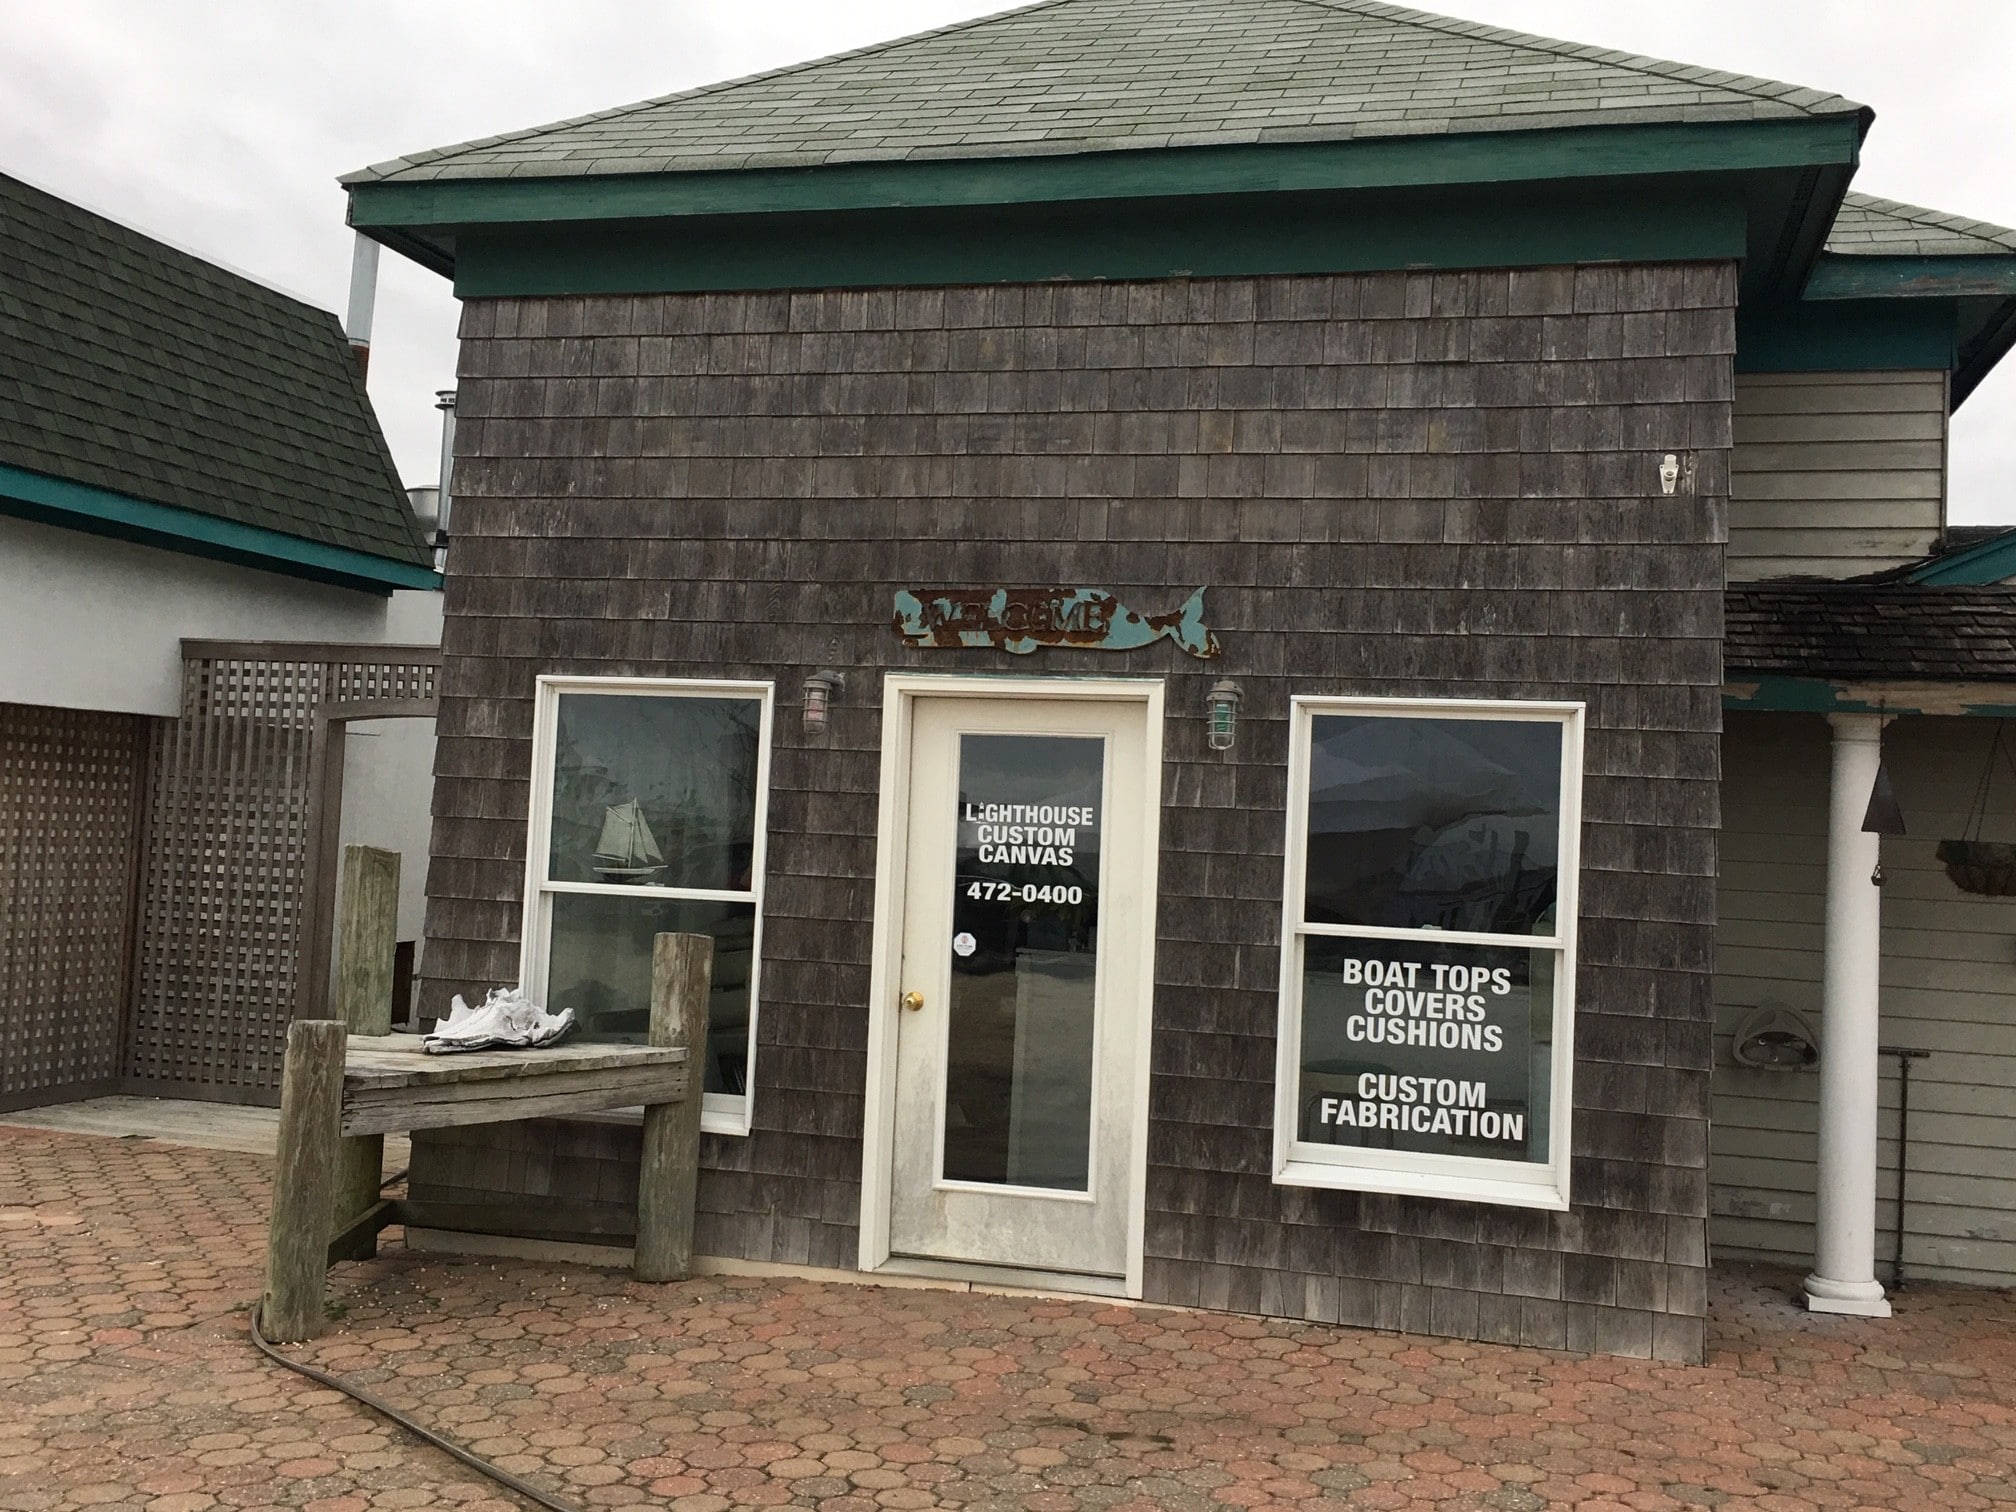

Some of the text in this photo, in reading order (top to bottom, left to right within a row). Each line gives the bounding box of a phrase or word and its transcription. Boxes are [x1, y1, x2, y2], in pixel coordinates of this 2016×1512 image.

[965, 802, 1094, 826] LIGHTHOUSE
[977, 825, 1076, 846] CUSTOM
[978, 844, 1074, 867] CANVAS
[967, 882, 1083, 905] 472-0400
[1343, 958, 1512, 995] BOAT TOPS
[1365, 988, 1487, 1022] COVERS
[1346, 1015, 1504, 1052] CUSHIONS
[1358, 1072, 1487, 1109] CUSTOM
[1320, 1097, 1525, 1141] FABRICATION
